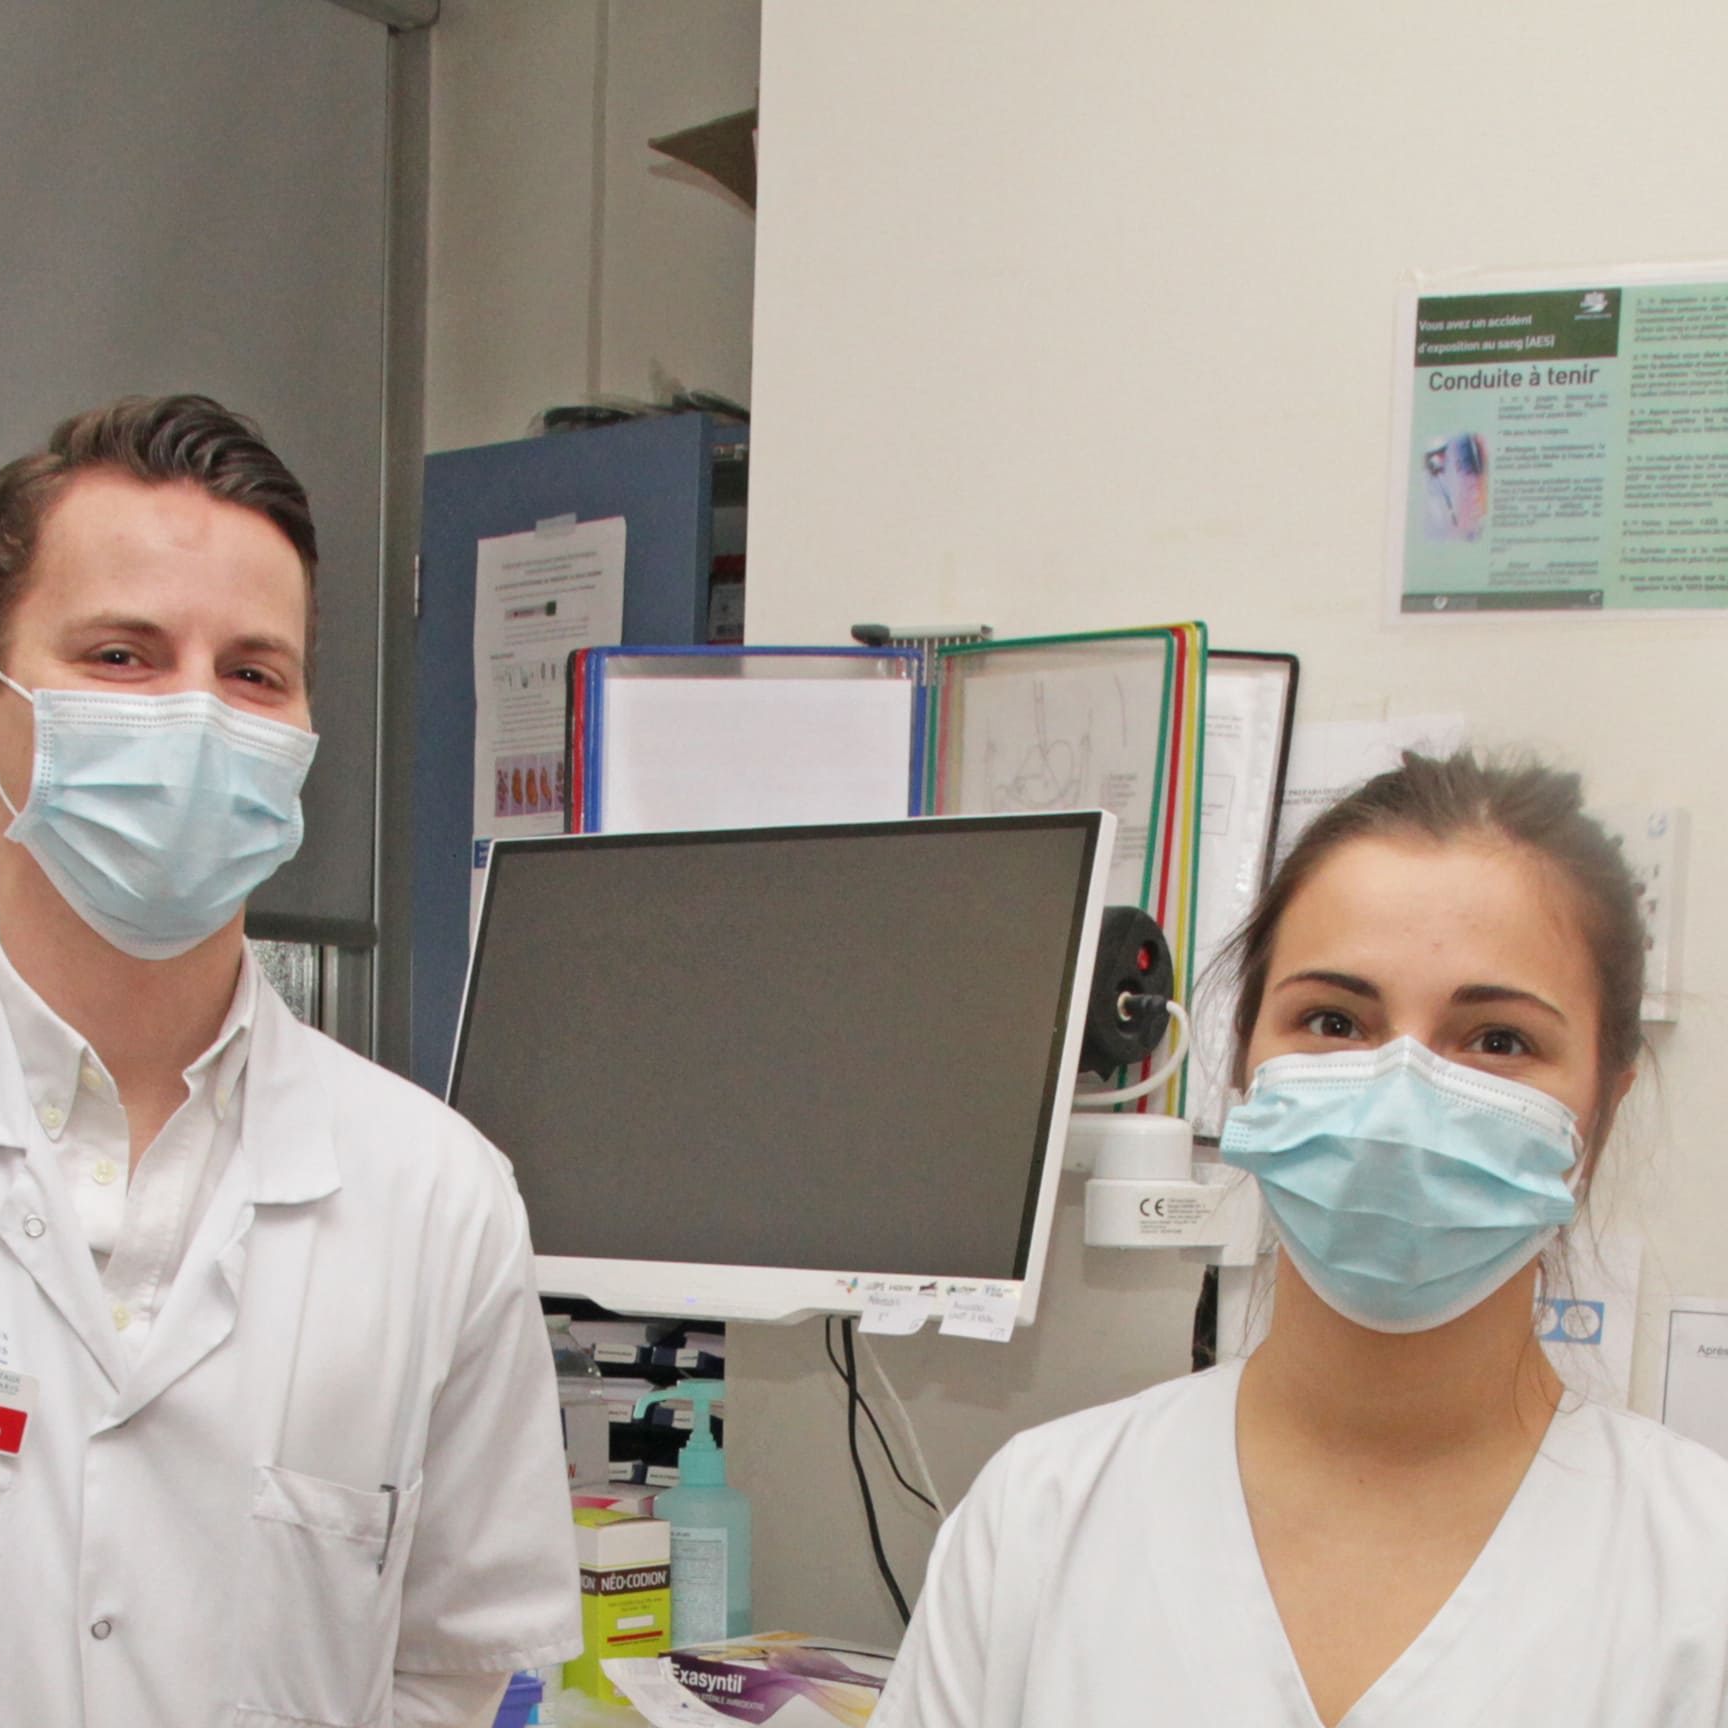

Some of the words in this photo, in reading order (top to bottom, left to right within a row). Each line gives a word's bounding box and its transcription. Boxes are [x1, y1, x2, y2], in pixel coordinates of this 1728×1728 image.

[1419, 321, 1444, 330] Vous
[1447, 320, 1470, 329] avez
[1488, 315, 1532, 326] accident
[1419, 340, 1480, 355] d'exposition
[1482, 341, 1494, 349] au
[1498, 339, 1523, 350] sang
[1429, 369, 1523, 391] Conduite
[1529, 366, 1541, 386] à
[1548, 364, 1599, 385] tenir
[1140, 1198, 1165, 1216] CE
[672, 1664, 742, 1693] Exasyntil
